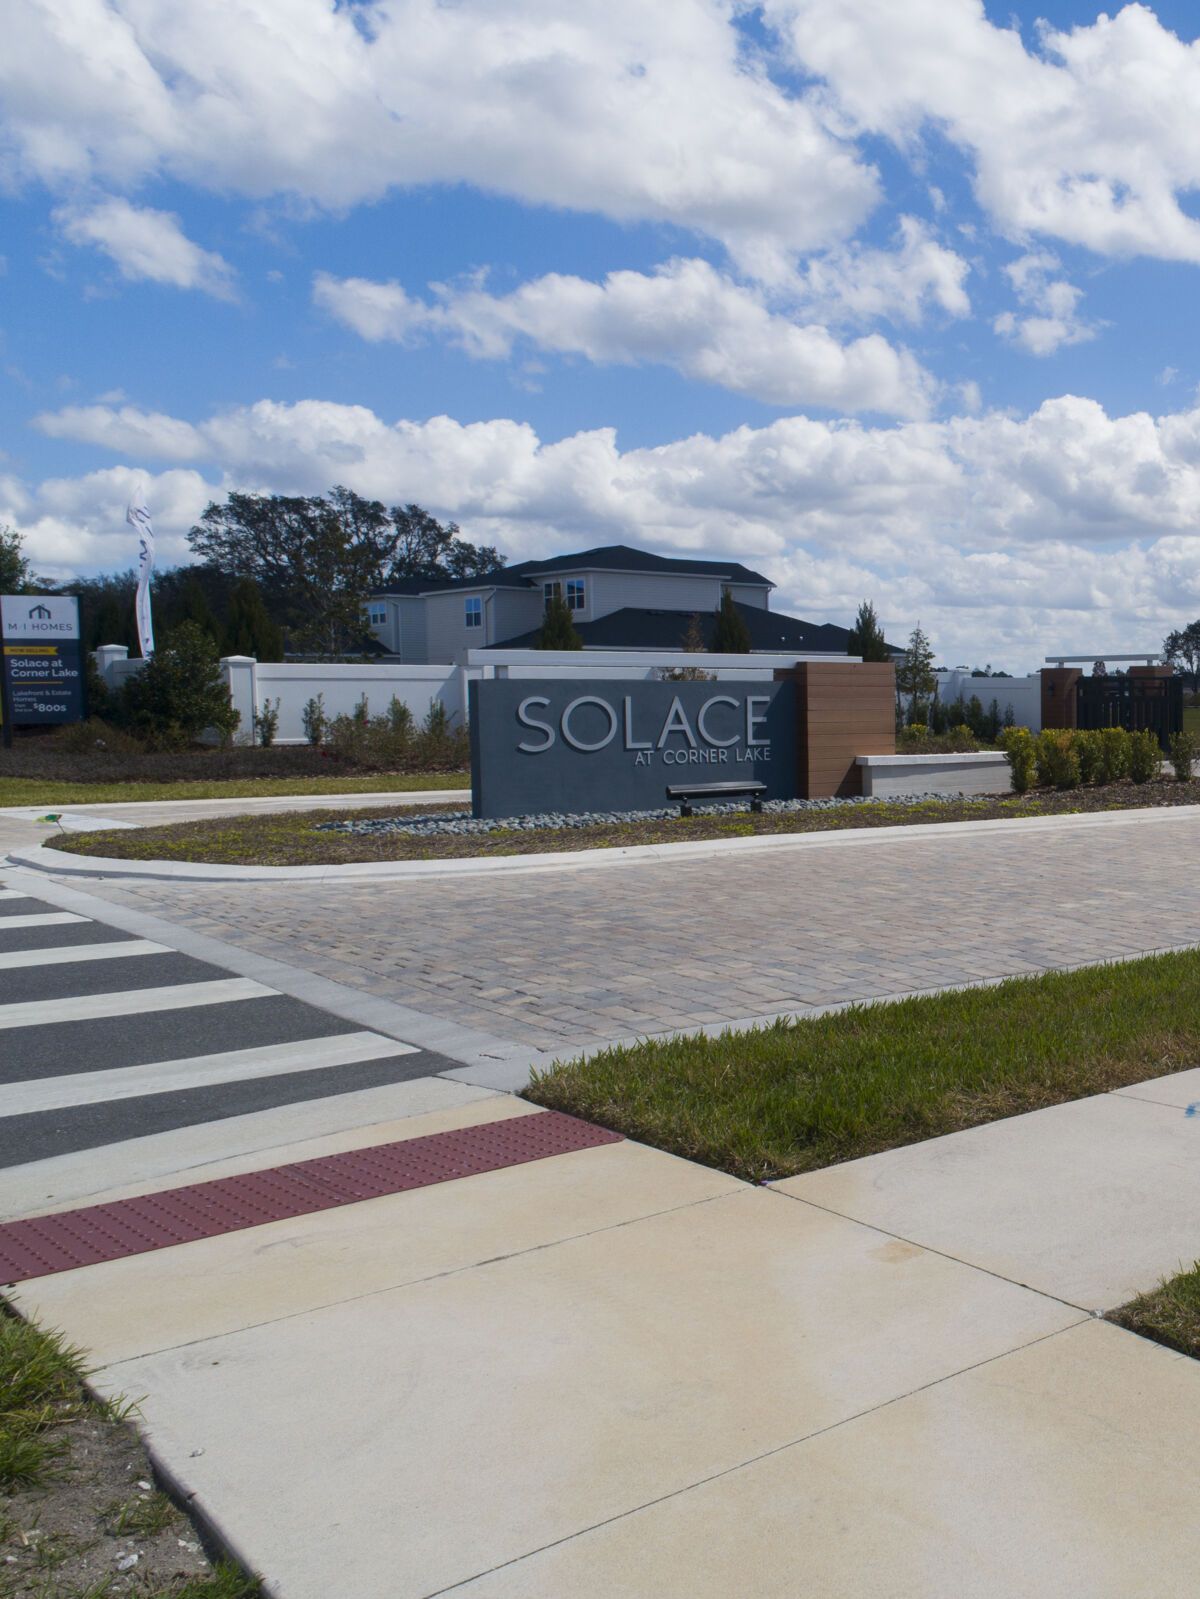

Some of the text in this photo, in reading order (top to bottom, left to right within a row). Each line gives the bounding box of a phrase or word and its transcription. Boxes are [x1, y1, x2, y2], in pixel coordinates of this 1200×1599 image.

[31, 623, 73, 631] HOMES
[10, 659, 63, 667] Solace at
[10, 668, 79, 677] Corner Lake
[33, 702, 67, 712] $800s
[517, 694, 771, 753] SOLACE
[634, 747, 772, 766] AT CORNER LAKE
